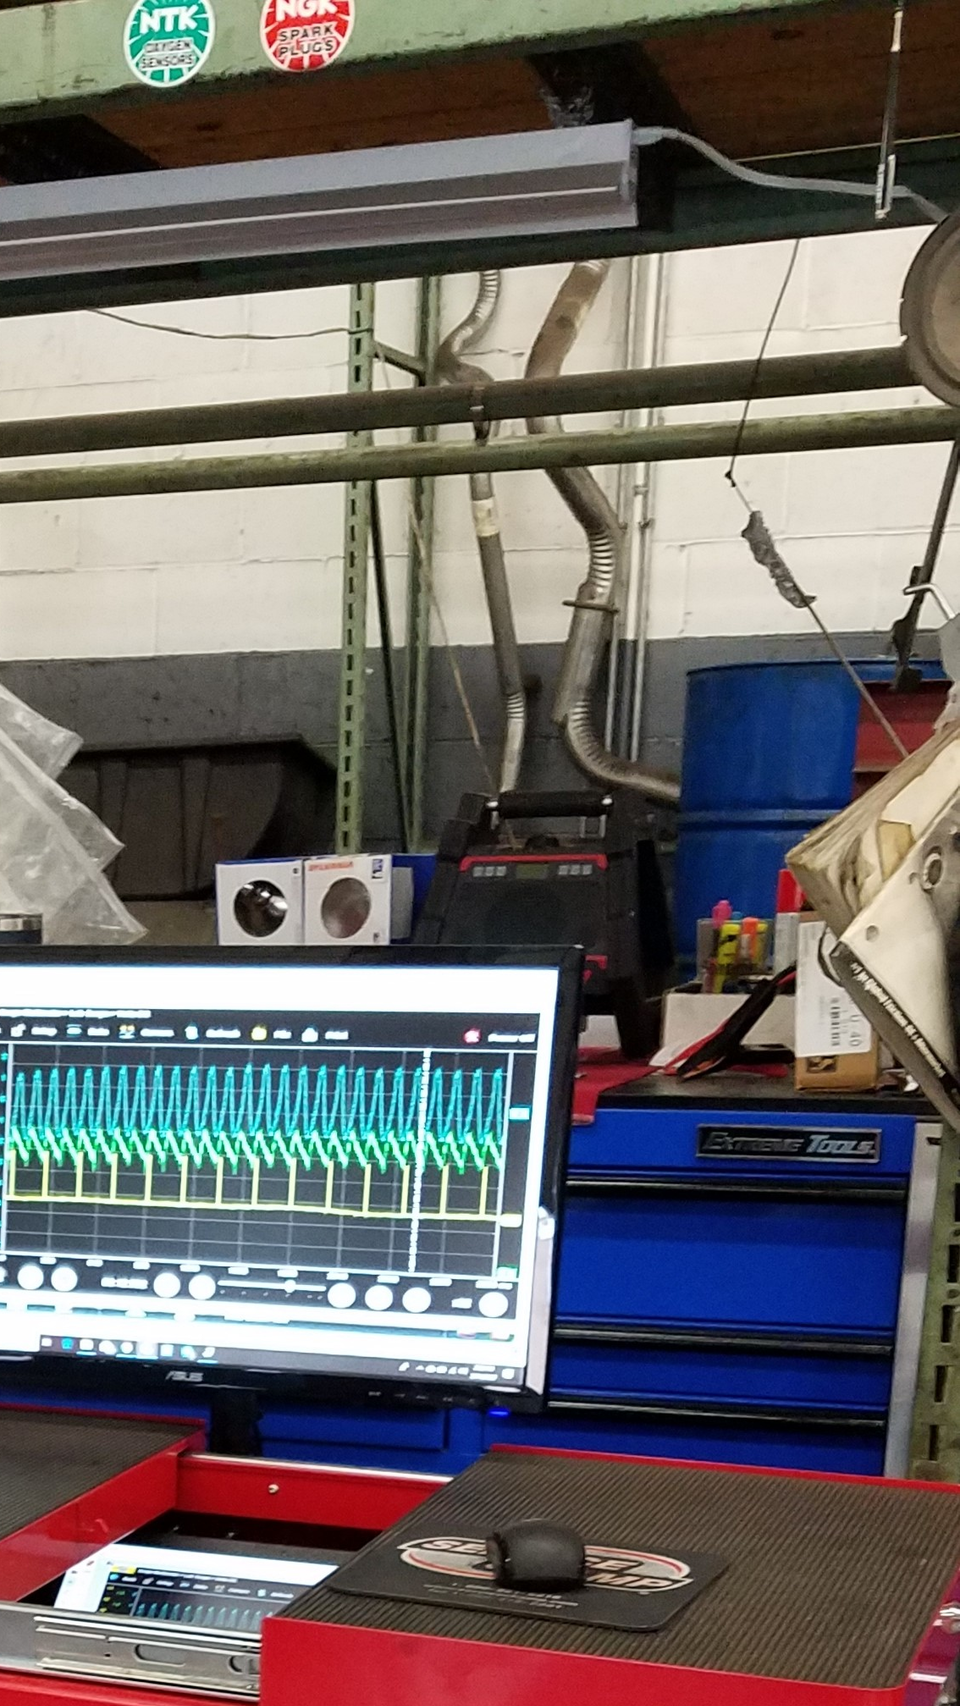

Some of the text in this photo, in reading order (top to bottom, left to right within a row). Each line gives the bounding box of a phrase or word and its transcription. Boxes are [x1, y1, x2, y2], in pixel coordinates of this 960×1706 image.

[275, 0, 338, 21] NGK
[139, 5, 199, 34] NTK
[279, 24, 334, 42] SPARK
[144, 40, 191, 53] OXYGEN
[279, 40, 334, 57] PLUGS
[141, 54, 194, 69] SENSORS
[164, 1370, 204, 1382] ASUS
